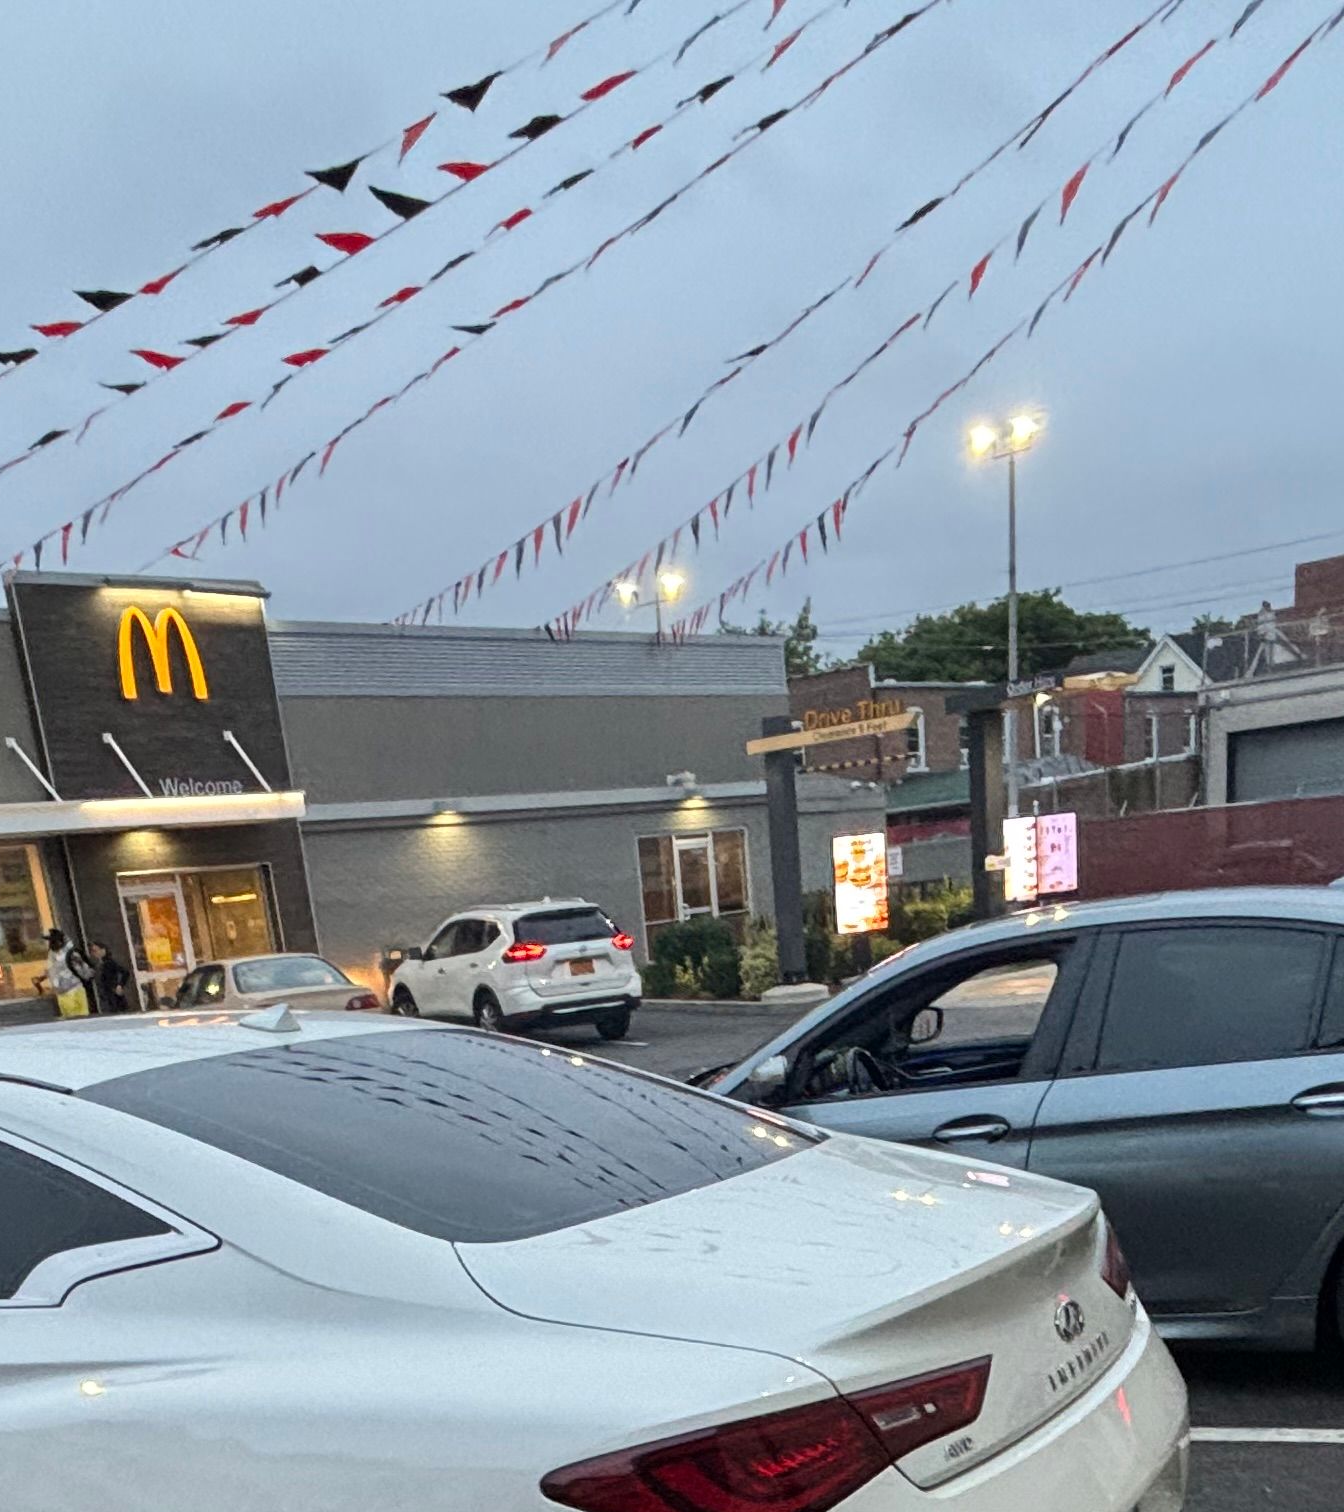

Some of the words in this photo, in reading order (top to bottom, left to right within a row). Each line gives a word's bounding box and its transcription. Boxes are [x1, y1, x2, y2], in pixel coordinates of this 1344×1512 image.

[804, 707, 852, 730] Drive
[856, 698, 903, 721] Thru
[158, 776, 243, 797] Welcome
[1047, 1331, 1110, 1393] INFINITI
